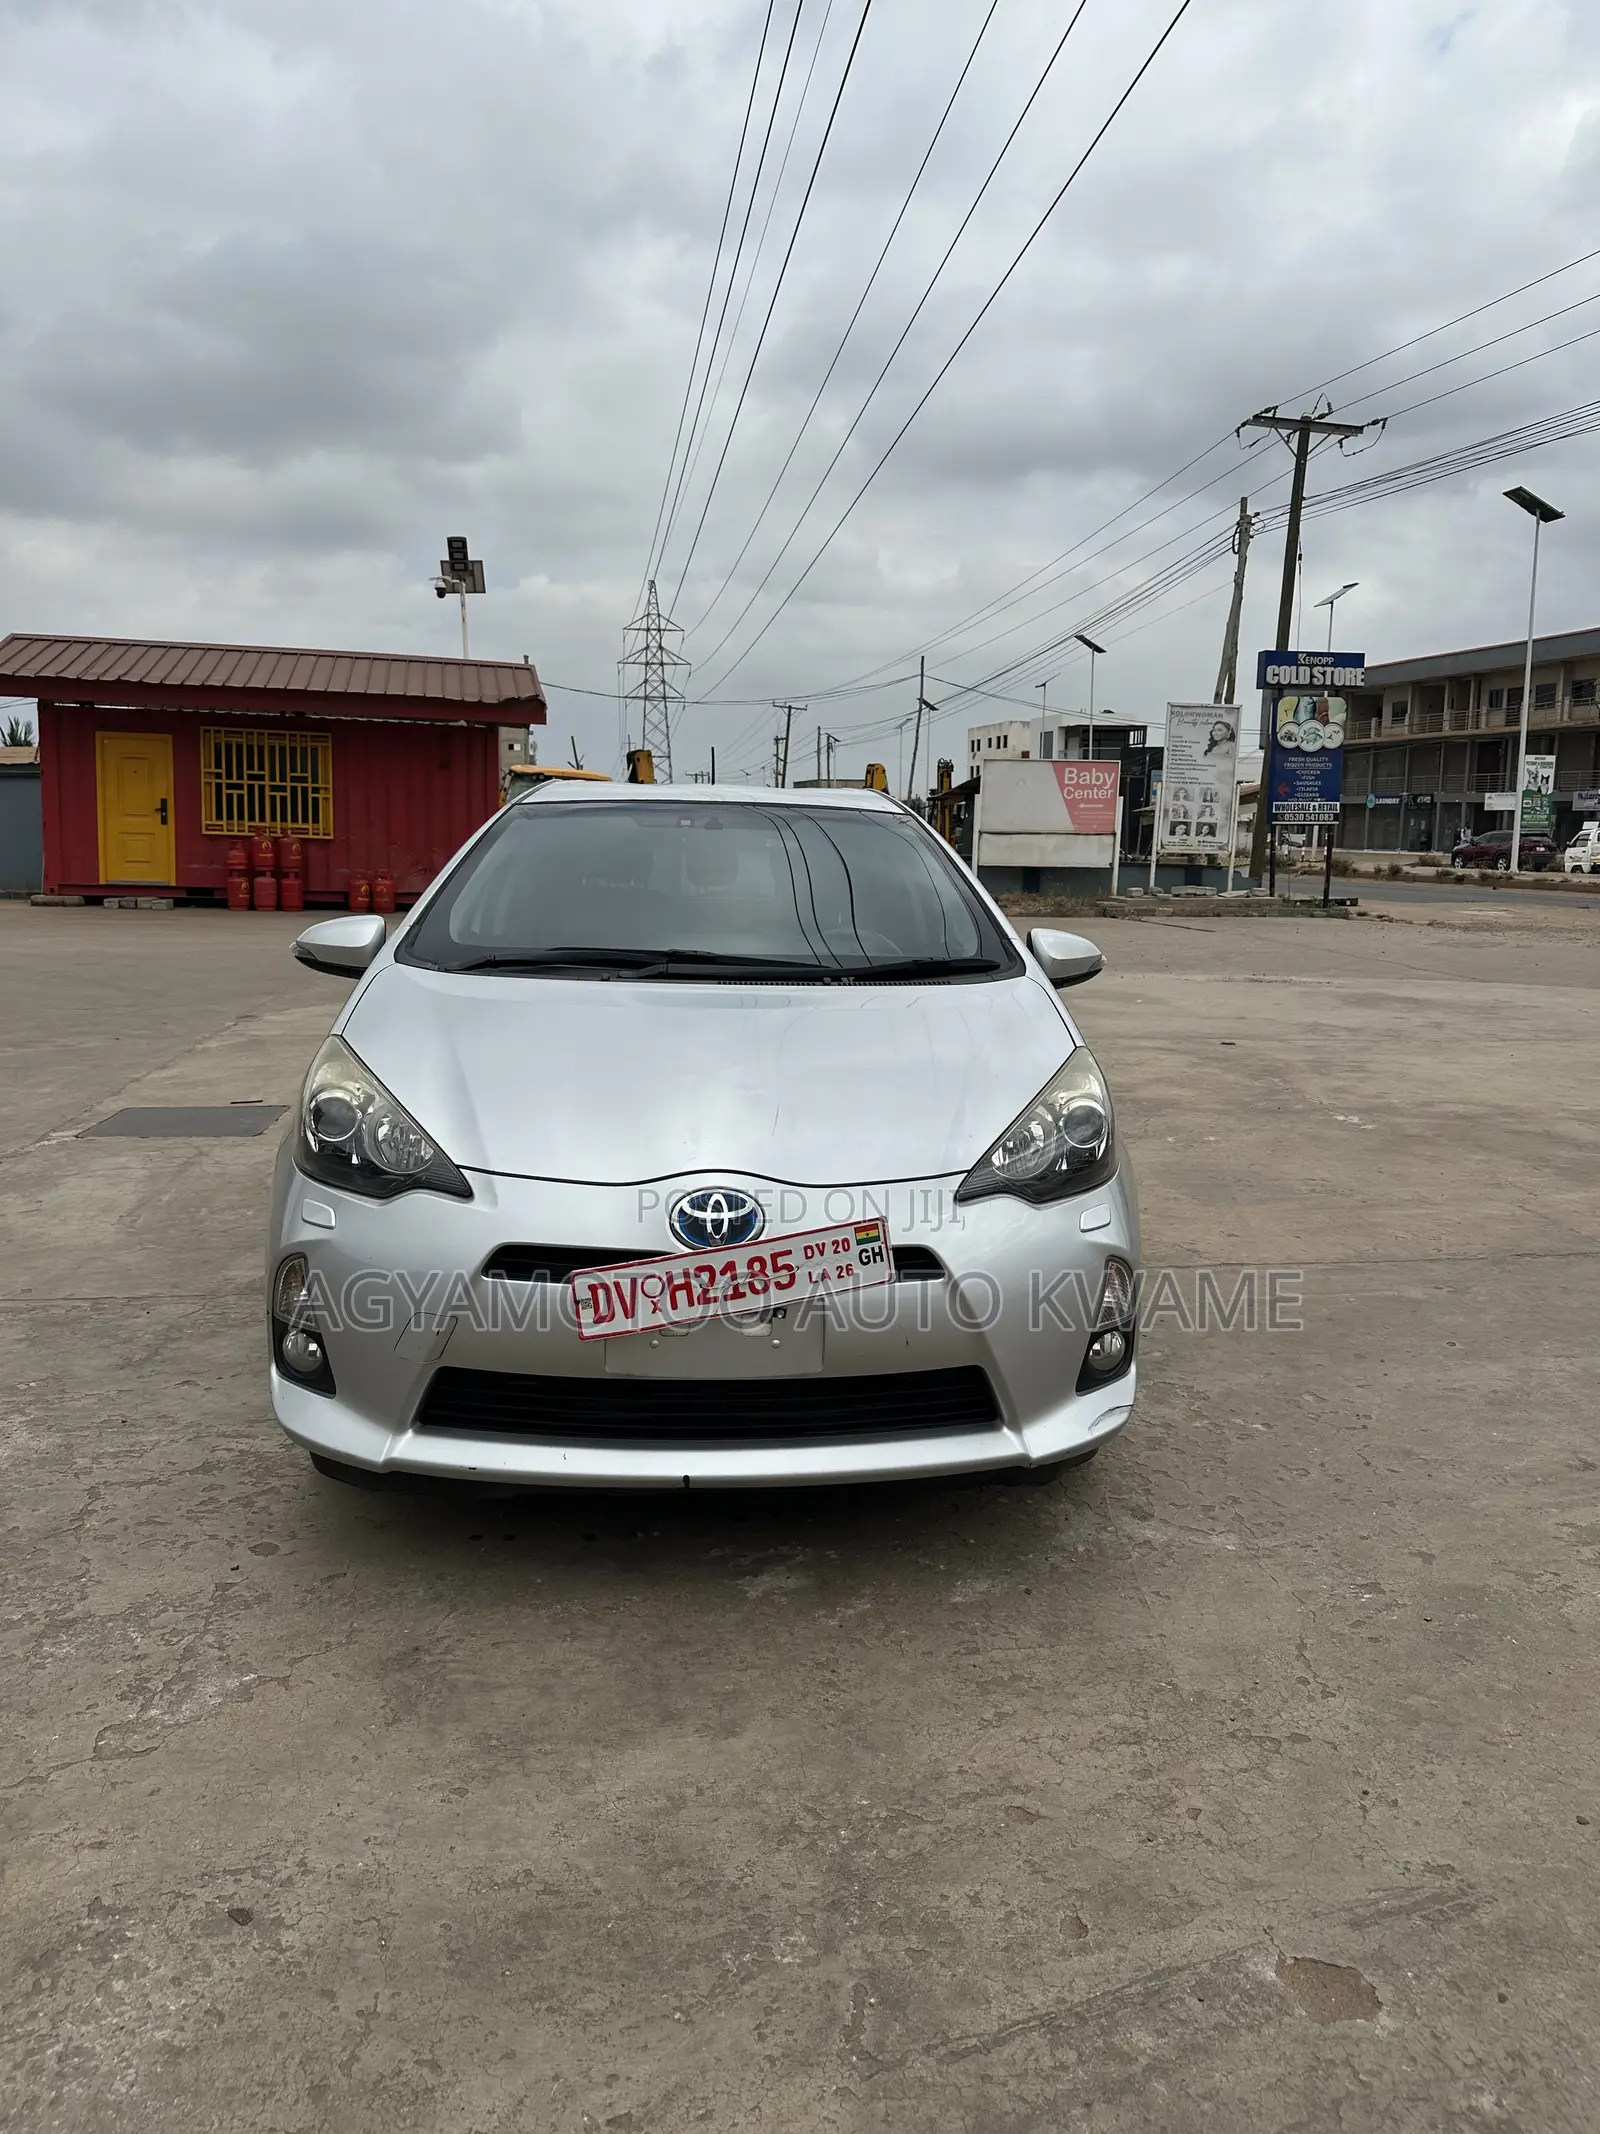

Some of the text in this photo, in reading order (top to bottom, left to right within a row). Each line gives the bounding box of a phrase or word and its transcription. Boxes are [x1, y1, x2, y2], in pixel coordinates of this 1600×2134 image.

[1298, 653, 1334, 665] KENOPP
[1266, 665, 1364, 686] COLD STORE
[1064, 768, 1115, 789] Baby
[1063, 787, 1114, 799] Center
[1275, 803, 1311, 812] WHOLESALE
[1318, 804, 1338, 812] RETAIL
[802, 1237, 851, 1260] DV 20
[858, 1245, 885, 1266] GH
[808, 1263, 854, 1285] LA 26
[588, 1277, 637, 1324] DV
